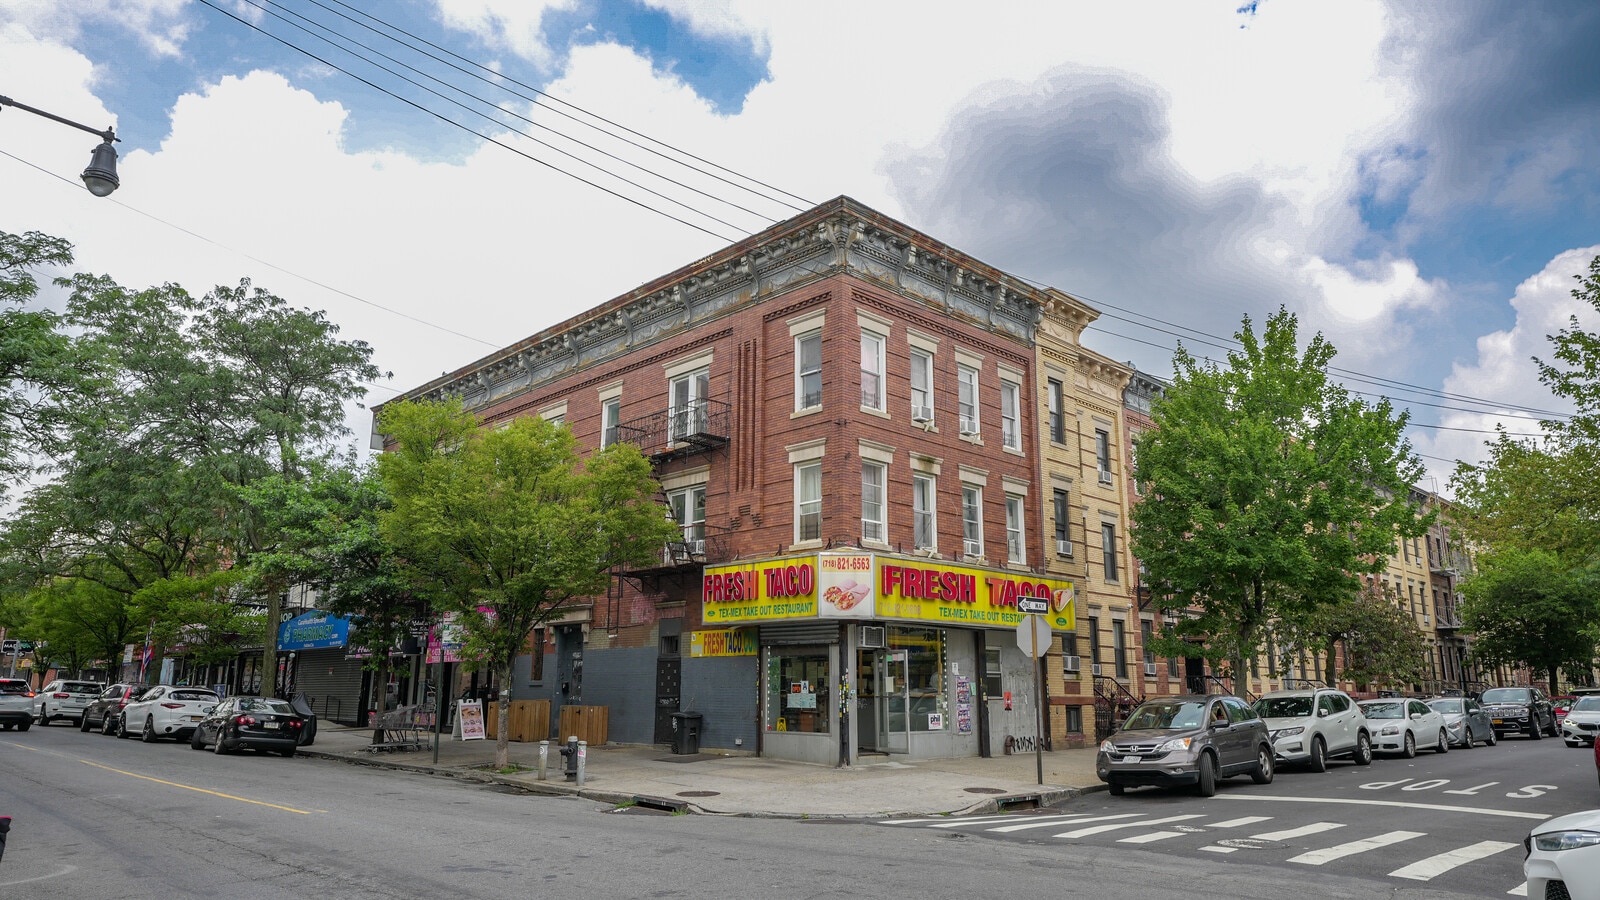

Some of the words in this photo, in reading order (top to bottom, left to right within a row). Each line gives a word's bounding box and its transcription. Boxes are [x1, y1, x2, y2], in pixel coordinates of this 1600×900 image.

[822, 559, 837, 568] (718)
[837, 557, 870, 570] 821-6563
[703, 570, 759, 602] FRESH
[764, 564, 815, 597] TACO
[881, 565, 976, 603] FRESH
[985, 577, 1050, 608] TACO
[719, 607, 742, 618] TEX-MEX
[743, 606, 758, 616] TAKE
[759, 605, 772, 616] OUT
[773, 602, 813, 615] RESTAURANT
[939, 607, 968, 619] TEX-MEX
[969, 609, 985, 620] TAKE
[986, 610, 1000, 621] OUT
[1001, 612, 1026, 623] RESTAU
[292, 624, 334, 642] PHARMACY
[930, 715, 941, 724] phil
[1359, 778, 1558, 799] STOP
